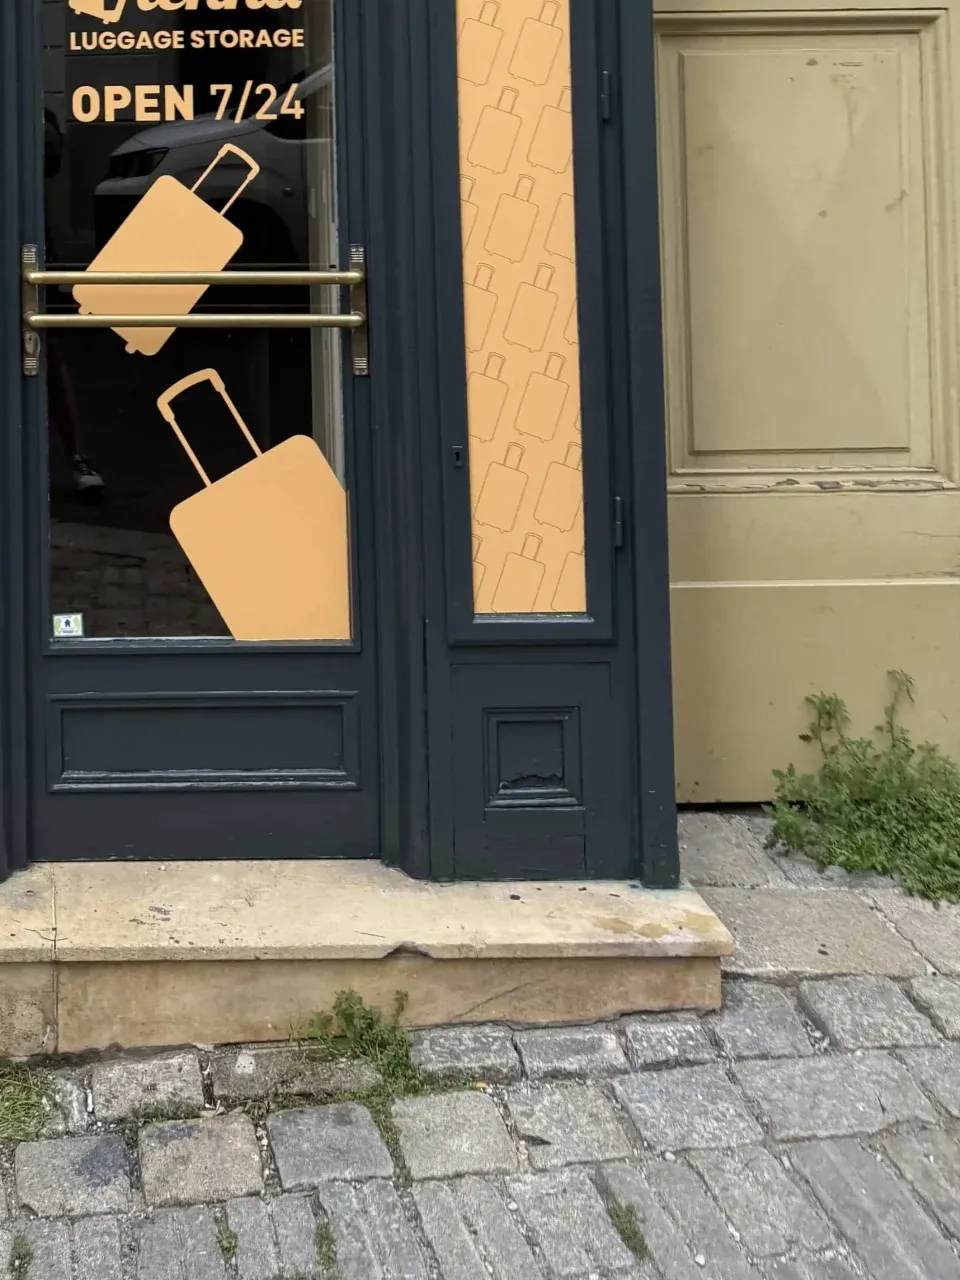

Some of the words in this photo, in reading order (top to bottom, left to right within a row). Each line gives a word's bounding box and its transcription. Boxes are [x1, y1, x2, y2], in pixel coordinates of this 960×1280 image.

[69, 30, 185, 51] LUGGAGE
[190, 28, 305, 49] STORAGE
[71, 84, 194, 123] OPEN
[209, 80, 306, 123] 7/24
